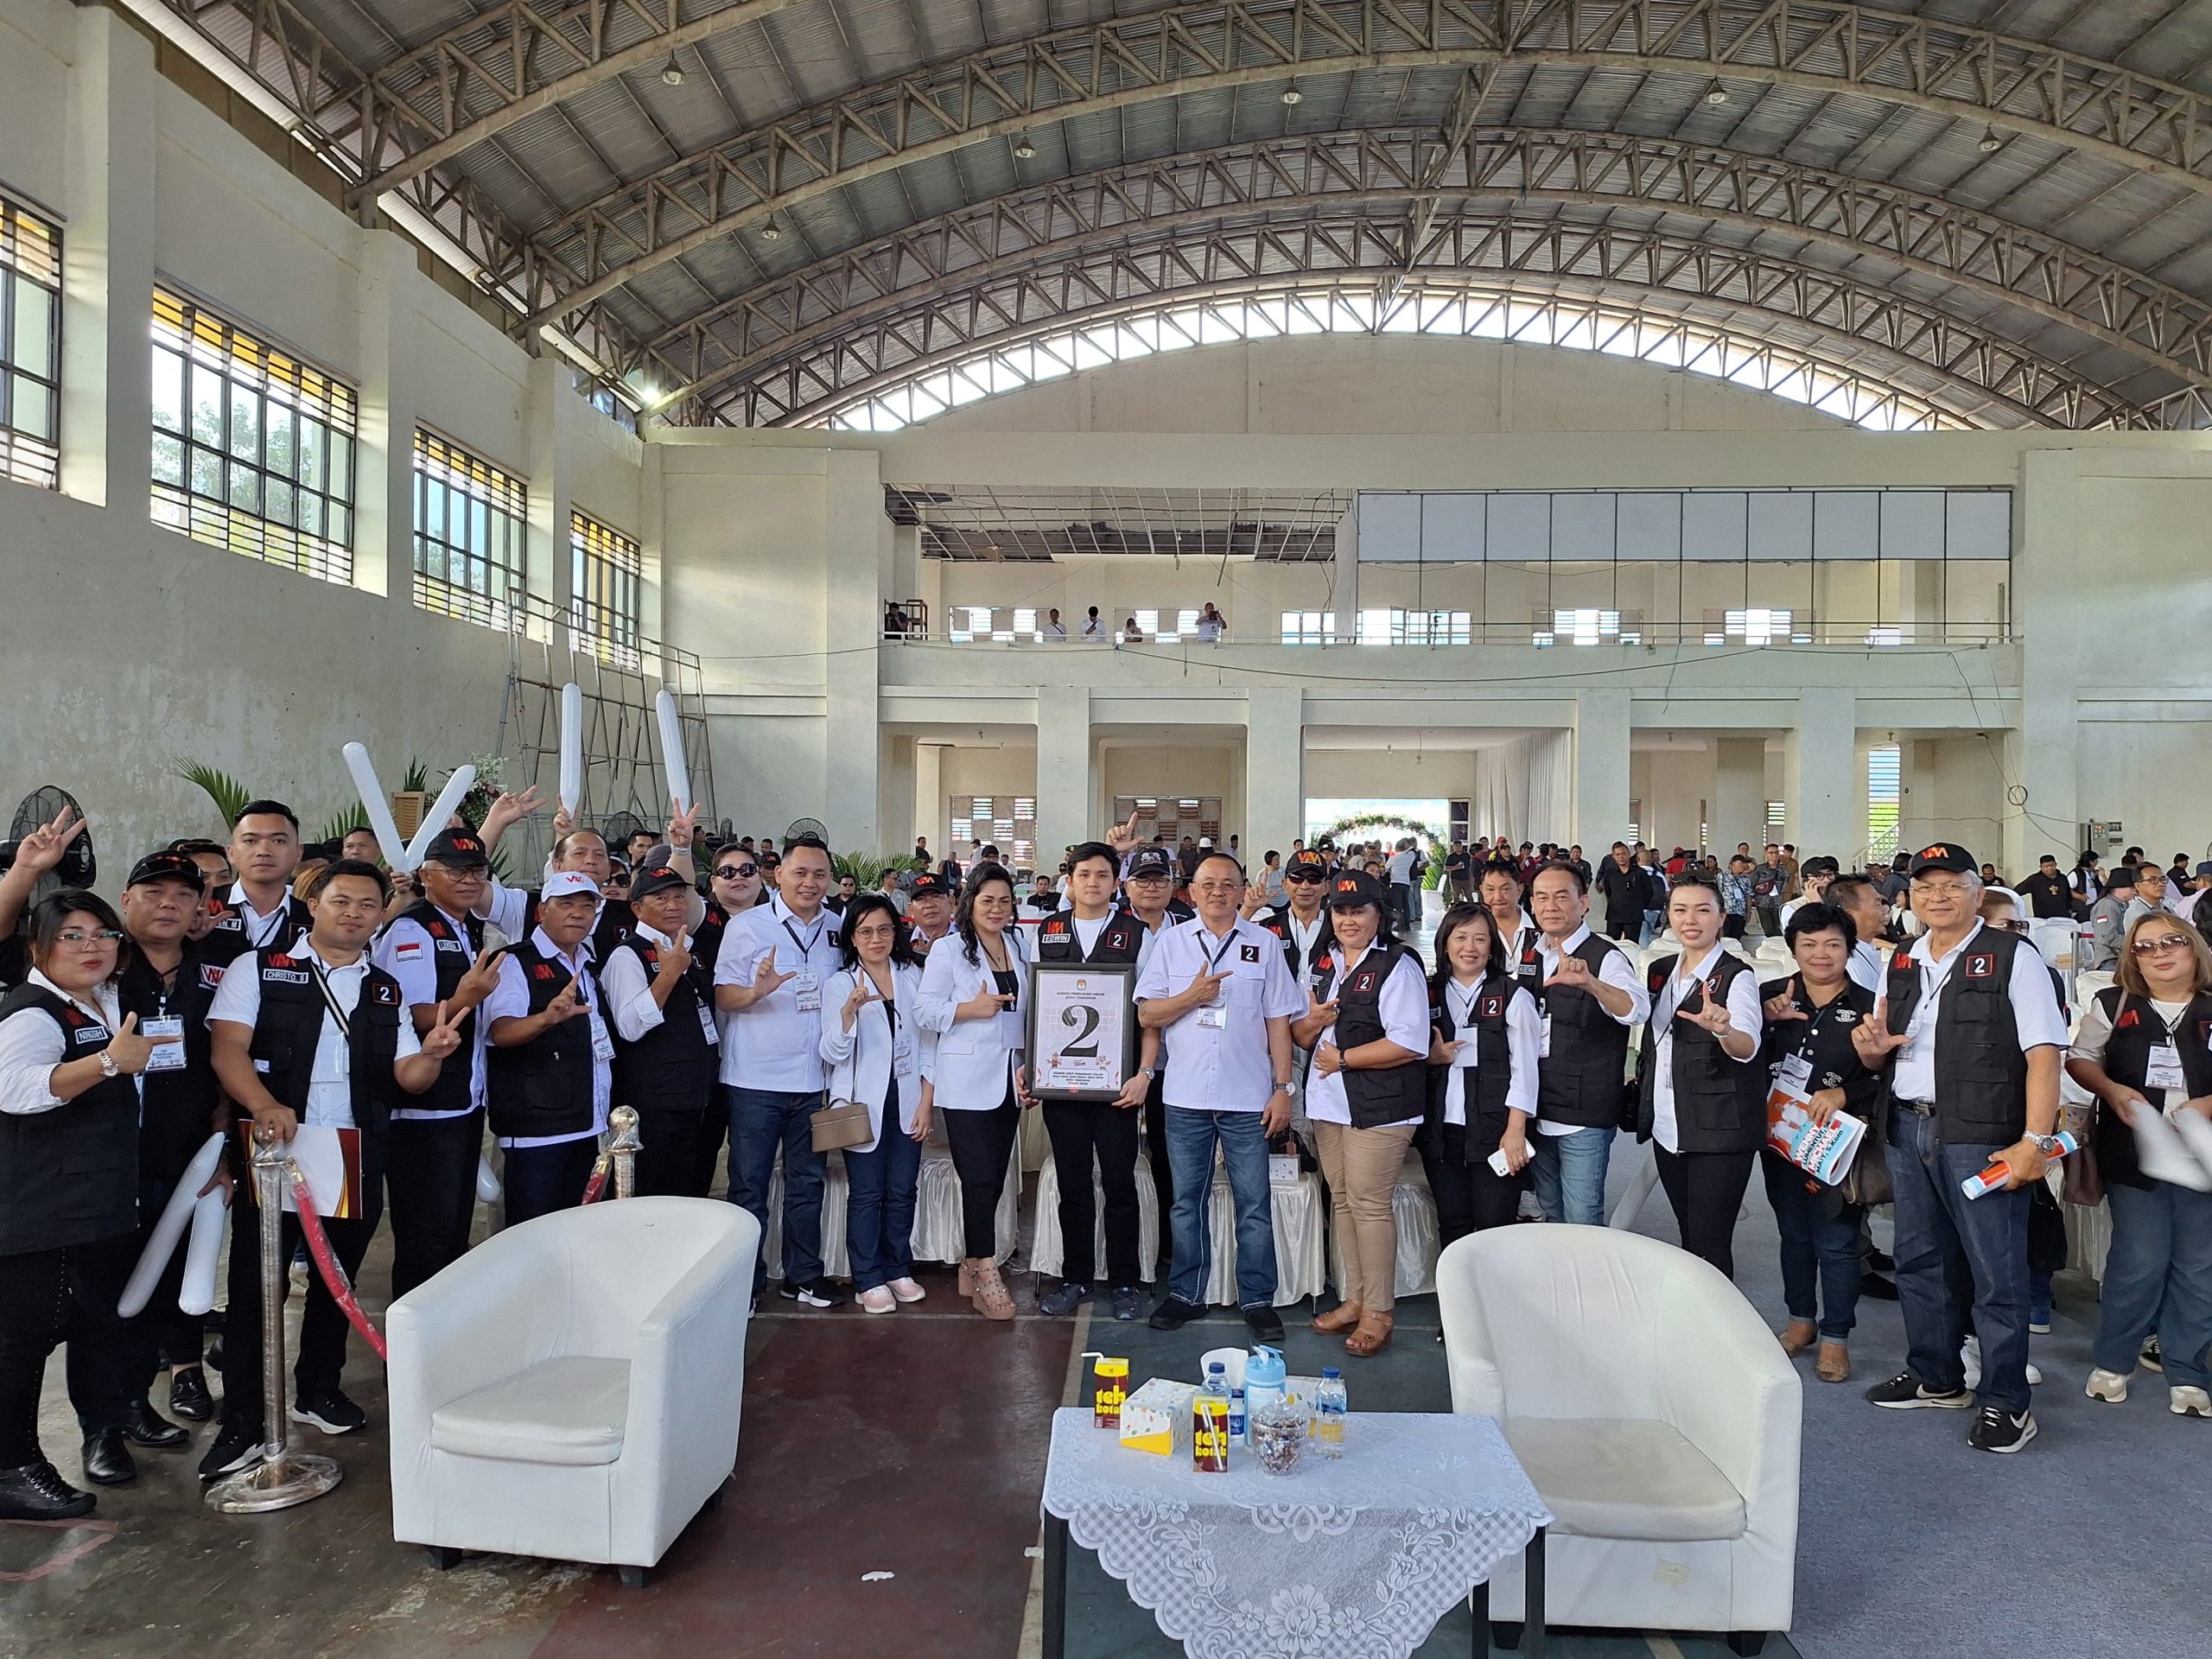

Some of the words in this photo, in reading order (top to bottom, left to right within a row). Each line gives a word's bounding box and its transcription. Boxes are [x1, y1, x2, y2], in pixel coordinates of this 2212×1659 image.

[619, 927, 626, 940] 2
[831, 932, 839, 946] 2
[1113, 934, 1122, 947] 2
[1245, 947, 1254, 960] 2
[692, 955, 702, 968] 2
[1974, 957, 1986, 974] 2
[267, 971, 298, 982] CHRISTO.
[1360, 976, 1370, 989] 2
[1707, 978, 1716, 992] 2
[379, 987, 391, 1001] 2
[1488, 999, 1497, 1014] 2
[1060, 1005, 1100, 1058] 2
[1795, 1123, 1821, 1161] WENNY
[1808, 1127, 1840, 1170] MICHAEL
[1096, 1385, 1127, 1405] teh
[1096, 1403, 1121, 1414] kota
[1195, 1425, 1227, 1446] teh
[1195, 1445, 1227, 1457] kotk
